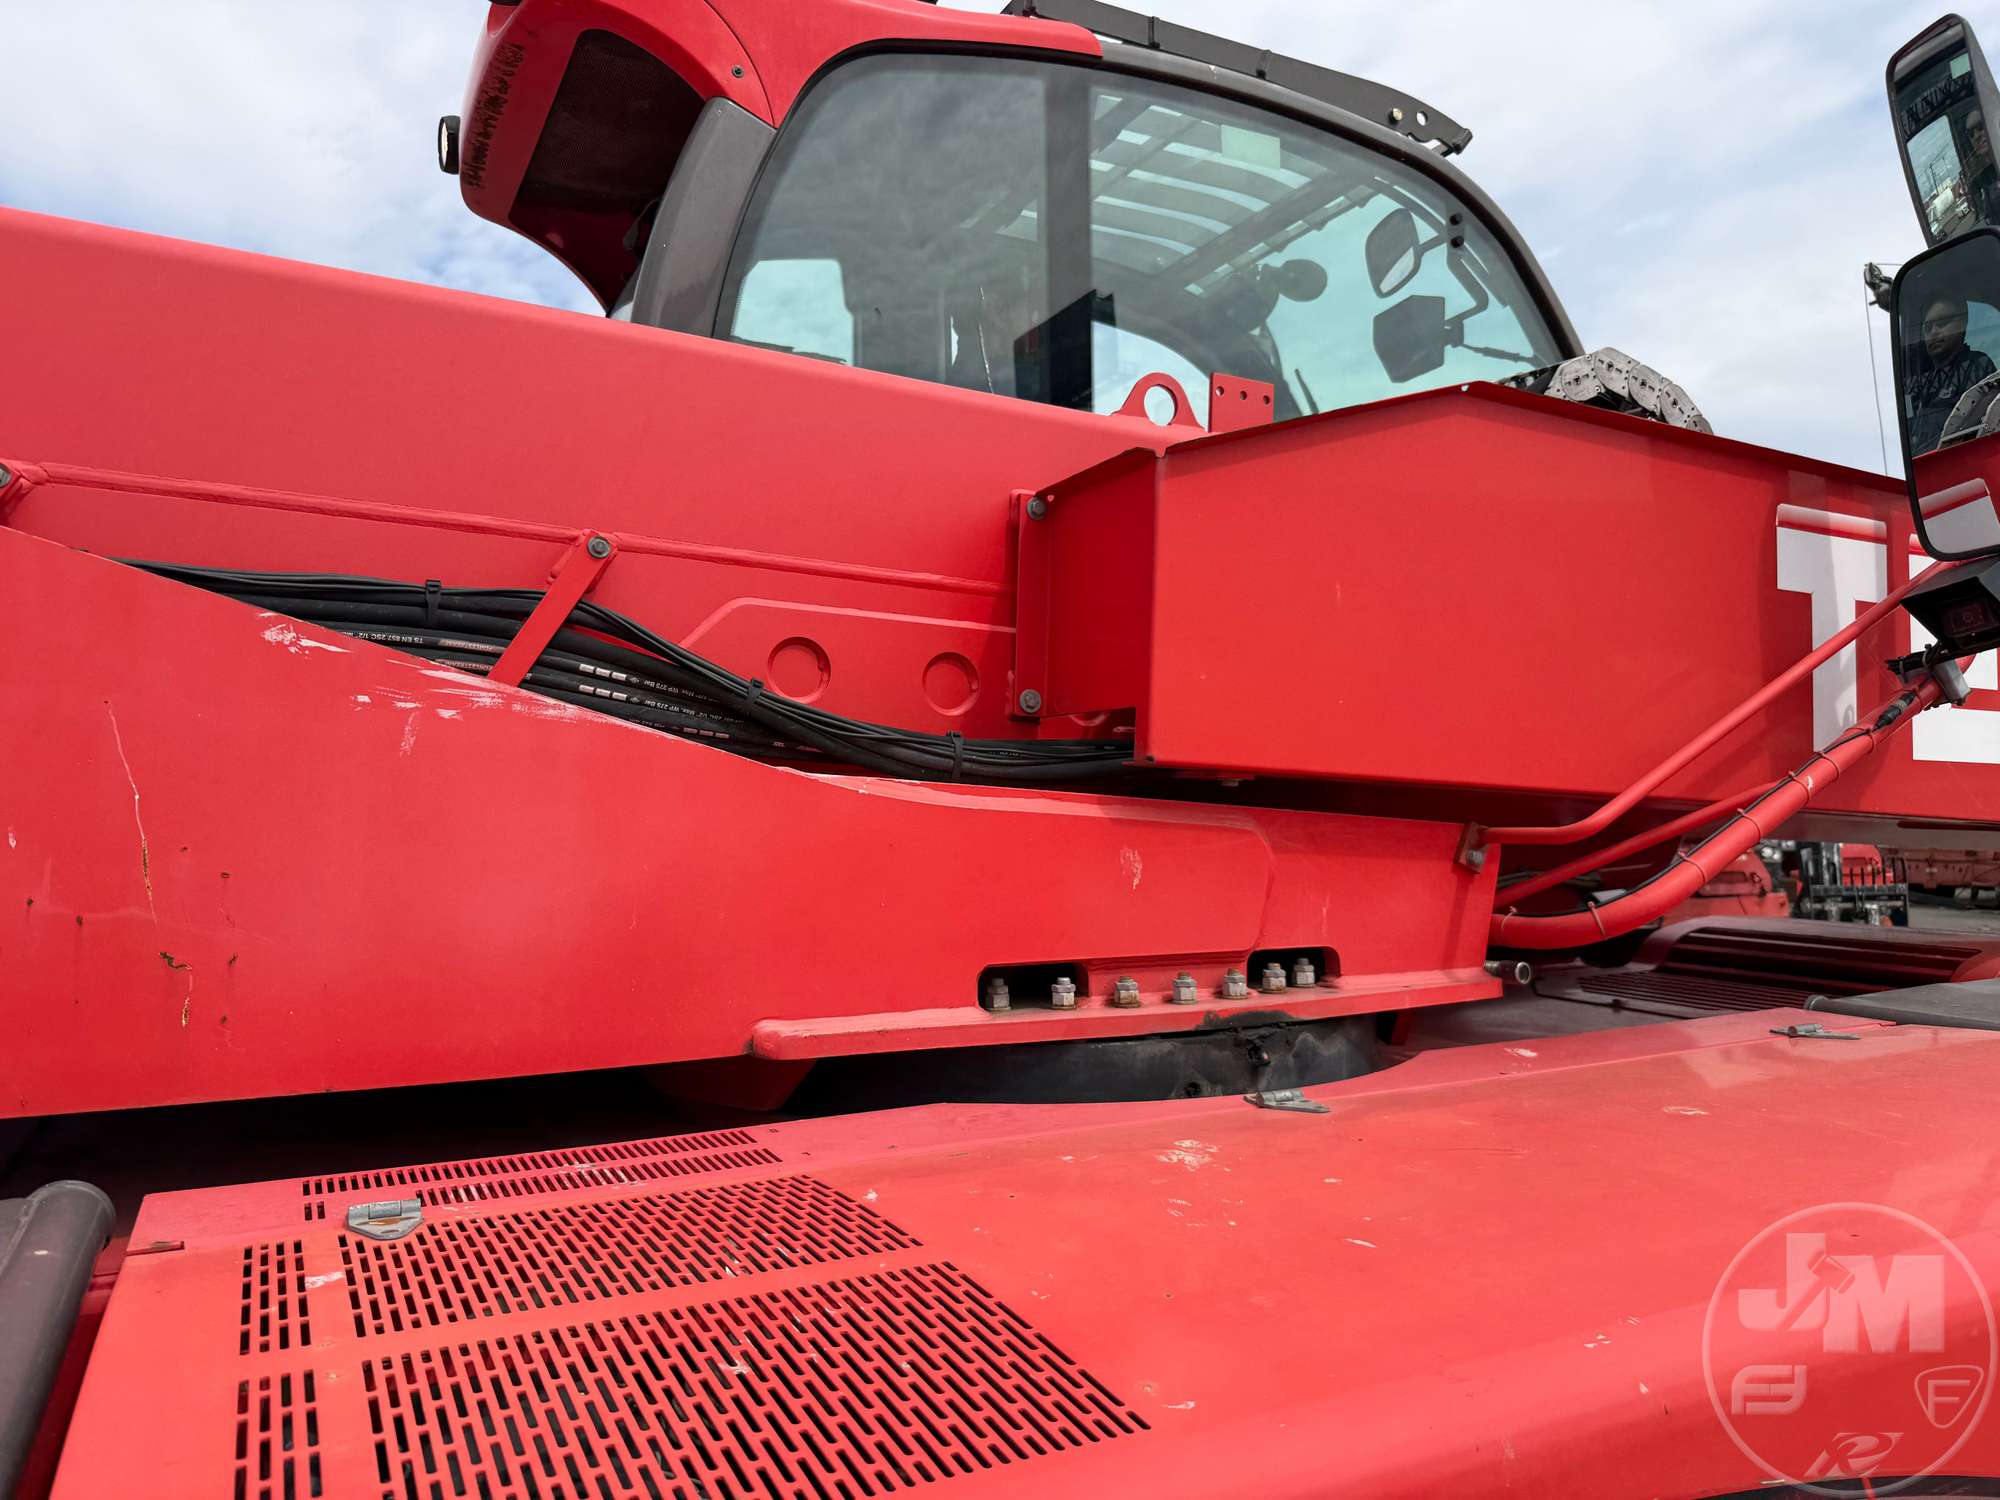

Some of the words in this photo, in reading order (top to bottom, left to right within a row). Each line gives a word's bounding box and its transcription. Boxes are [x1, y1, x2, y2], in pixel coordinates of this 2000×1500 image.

[387, 634, 401, 642] 857
[644, 679, 655, 687] Bar
[655, 683, 668, 691] 275
[644, 699, 656, 708] Bar
[656, 702, 669, 711] 275
[669, 705, 680, 713] WP
